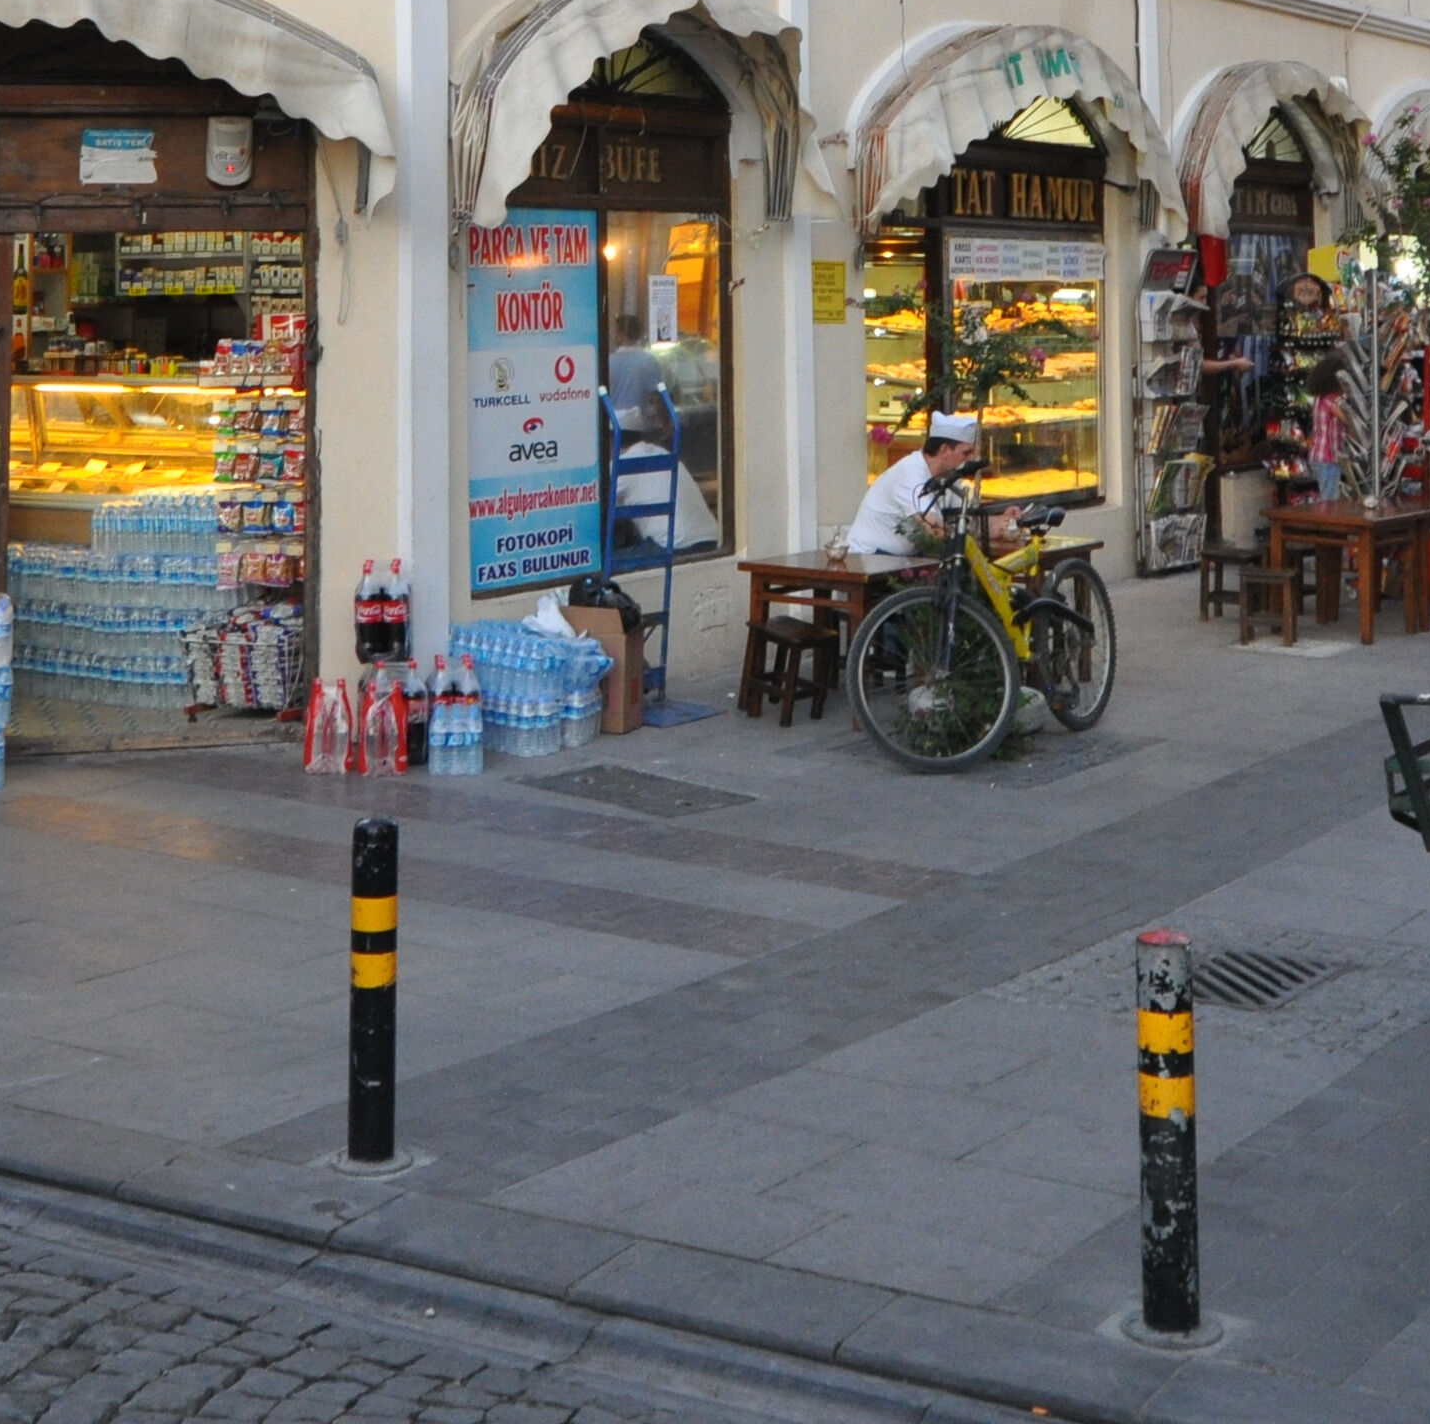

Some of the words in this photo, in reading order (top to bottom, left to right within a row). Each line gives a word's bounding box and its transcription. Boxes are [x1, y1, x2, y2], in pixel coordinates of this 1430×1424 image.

[530, 143, 567, 181] IZ
[599, 136, 661, 183] BÜFE
[951, 167, 996, 216] TAT
[1011, 172, 1096, 222] HAMUR
[468, 225, 525, 278] PARÇA
[529, 225, 550, 265] VE
[553, 225, 589, 265] TAM
[497, 281, 564, 332] KONTÖR
[472, 394, 532, 409] TURKCELL
[538, 387, 591, 403] vodafone
[508, 439, 559, 462] avea
[497, 522, 573, 554] FOTOKOPİ
[478, 561, 517, 583] FAXS
[522, 548, 590, 575] BULUNUR
